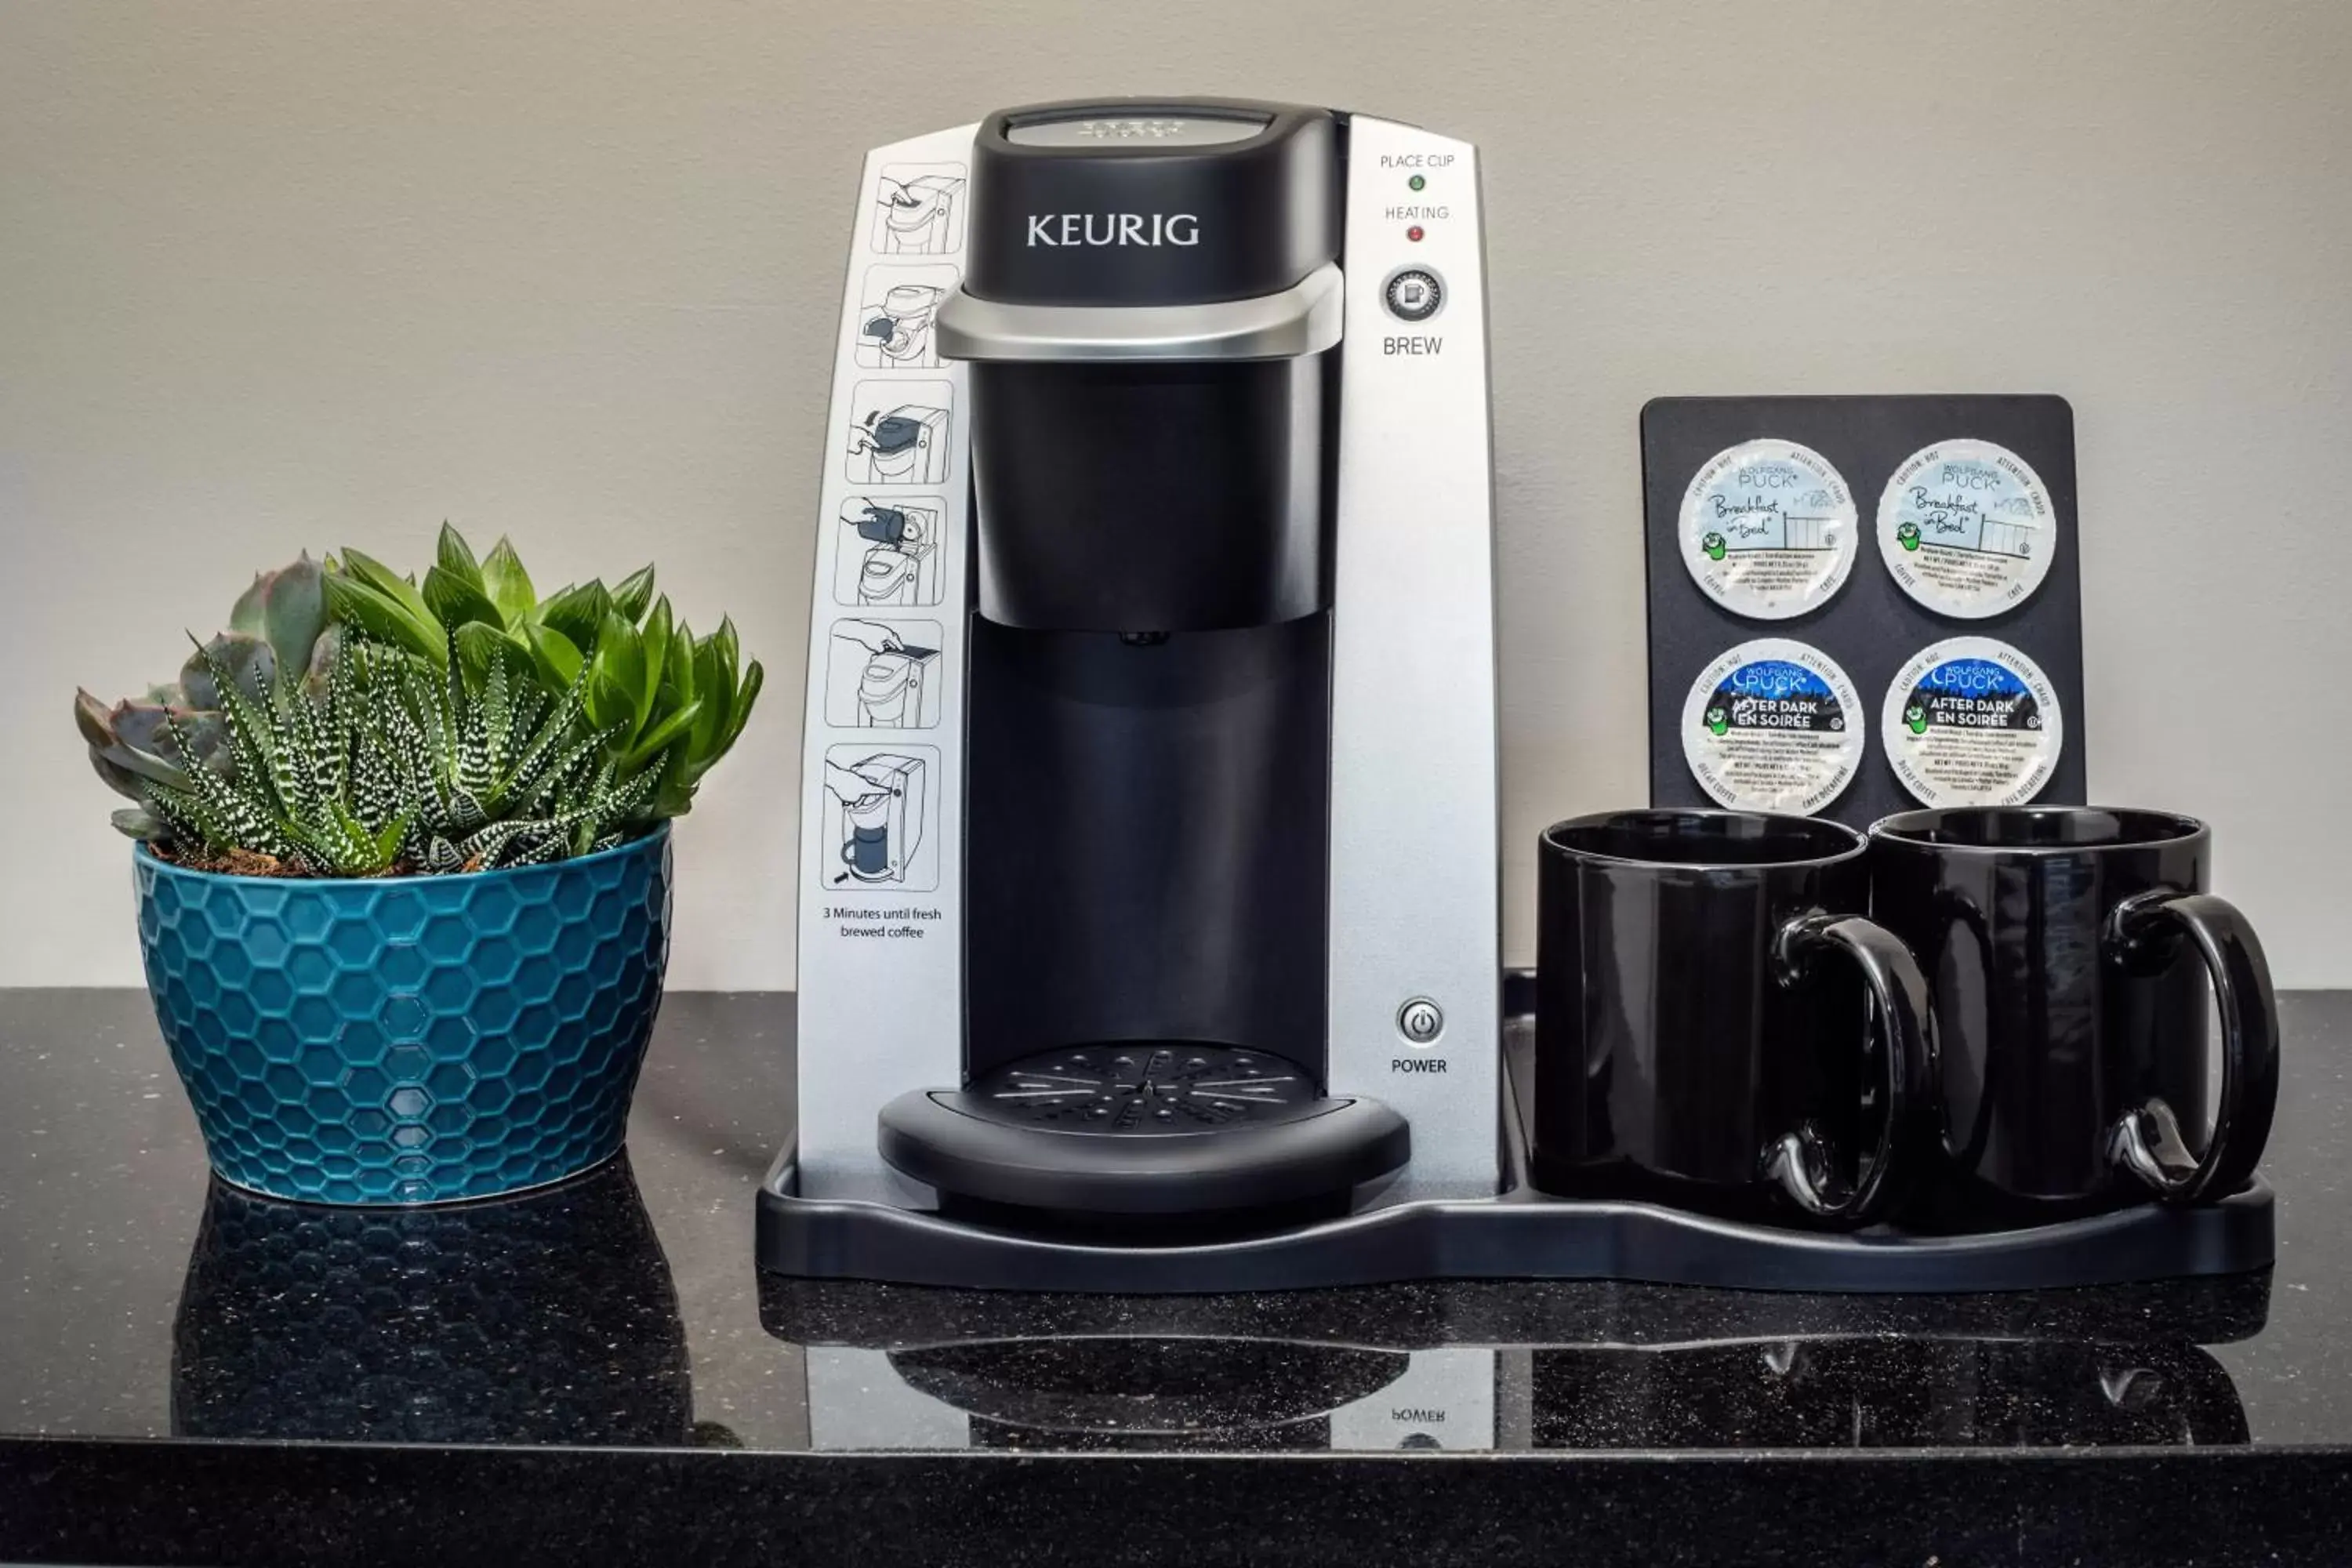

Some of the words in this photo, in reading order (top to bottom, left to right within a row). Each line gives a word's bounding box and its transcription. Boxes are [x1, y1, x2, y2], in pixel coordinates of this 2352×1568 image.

[1380, 154, 1424, 168] PLACE
[1427, 154, 1455, 168] CUP
[1385, 205, 1450, 220] HEATING
[1026, 213, 1200, 247] KEURIG
[1383, 336, 1443, 355] BREW
[1738, 474, 1795, 489] PUCK
[1941, 471, 1996, 492] PUCK
[1708, 493, 1780, 518] Breakfast
[1908, 485, 1979, 516] Breakfast
[1923, 514, 1936, 525] in
[1929, 510, 1966, 534] Bed
[1747, 666, 1804, 677] WOLFGANG
[1946, 665, 2000, 675] WOLFGANG
[1745, 674, 1802, 691] PUCK
[1945, 673, 1998, 689] PUCK
[1732, 699, 1777, 713] AFTER
[1780, 700, 1819, 714] DARK
[1930, 696, 1975, 711] AFTER
[1976, 699, 2015, 713] DARK
[1737, 713, 1757, 725] EN
[1760, 713, 1812, 728] SOIRÉE
[1936, 711, 1955, 724] EN
[1958, 711, 2008, 727] SOIRÉE
[823, 907, 831, 919] 3
[833, 906, 881, 920] Minutes
[883, 906, 910, 920] until
[912, 906, 942, 920] fresh
[840, 924, 885, 938] brewed
[887, 925, 925, 938] coffee
[1392, 1058, 1447, 1073] POWER
